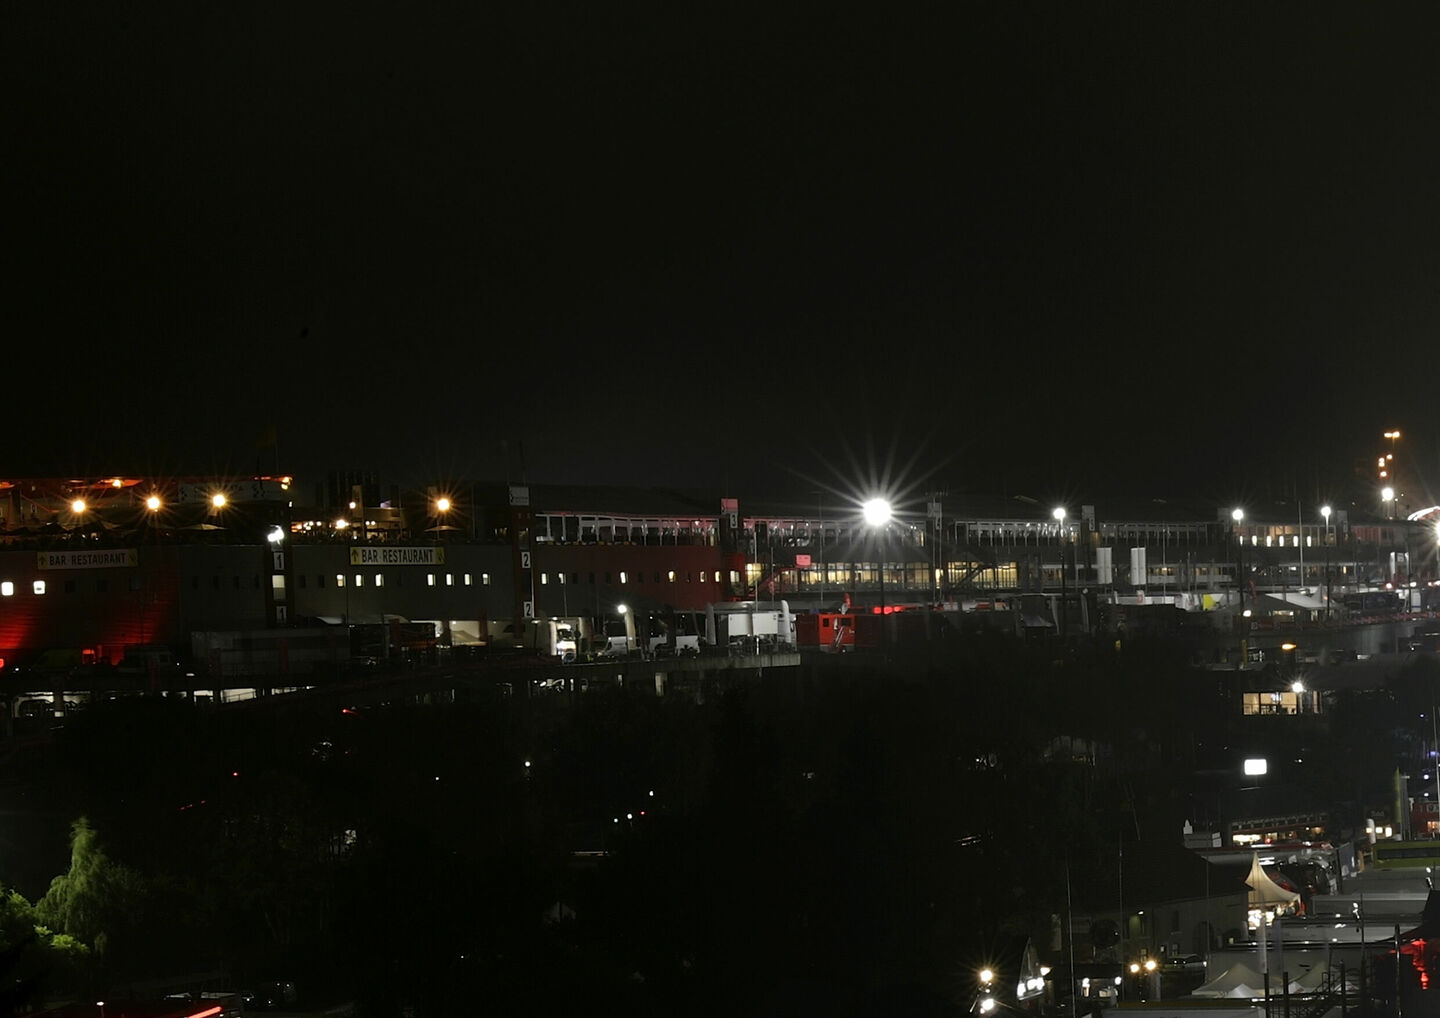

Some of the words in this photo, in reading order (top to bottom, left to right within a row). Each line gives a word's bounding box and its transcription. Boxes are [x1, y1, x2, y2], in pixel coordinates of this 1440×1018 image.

[49, 555, 68, 566] BAR
[71, 553, 127, 566] RESTAURANT
[361, 549, 378, 563] BAR
[383, 549, 434, 563] RESTAURANT
